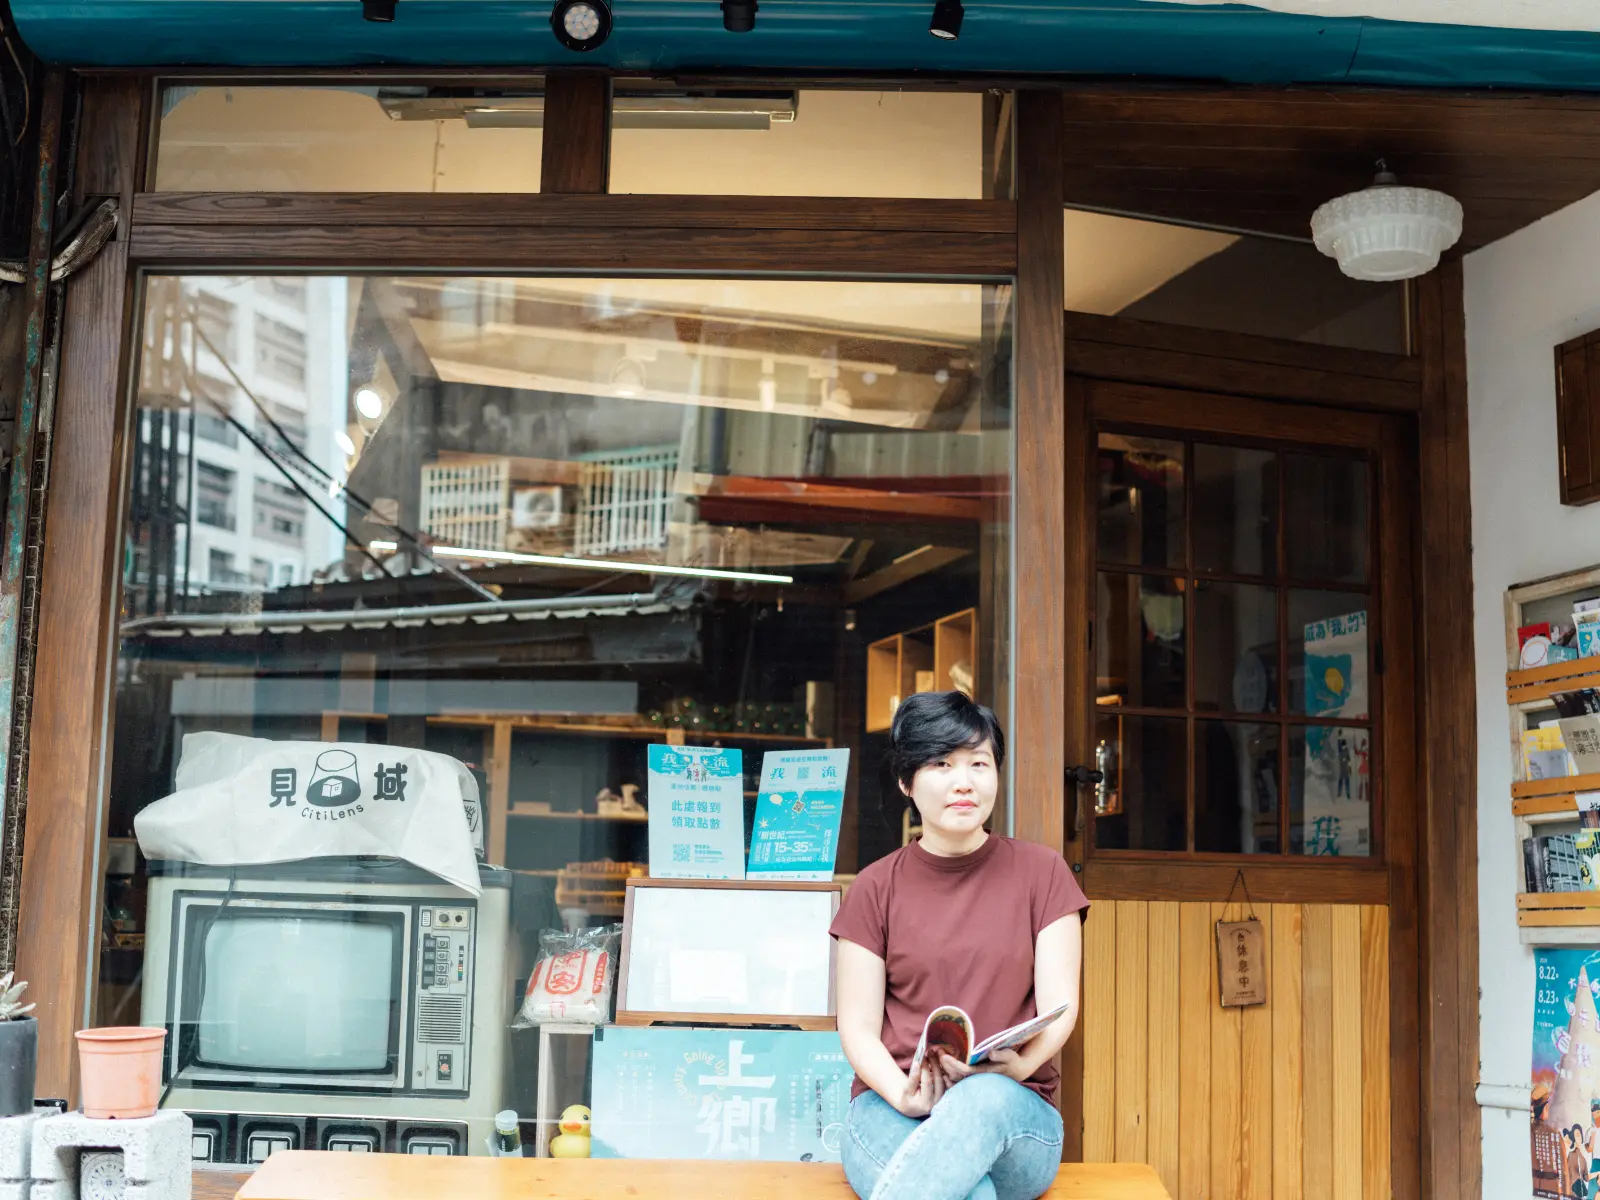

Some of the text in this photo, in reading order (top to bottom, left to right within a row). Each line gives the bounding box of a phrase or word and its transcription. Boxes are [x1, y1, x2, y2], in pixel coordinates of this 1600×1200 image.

[661, 752, 677, 765] 我
[770, 765, 837, 780] 我 流
[269, 763, 408, 807] 見 域
[301, 803, 364, 821] CitiLens
[671, 799, 721, 814] 此處報到
[671, 815, 721, 830] 領取點數
